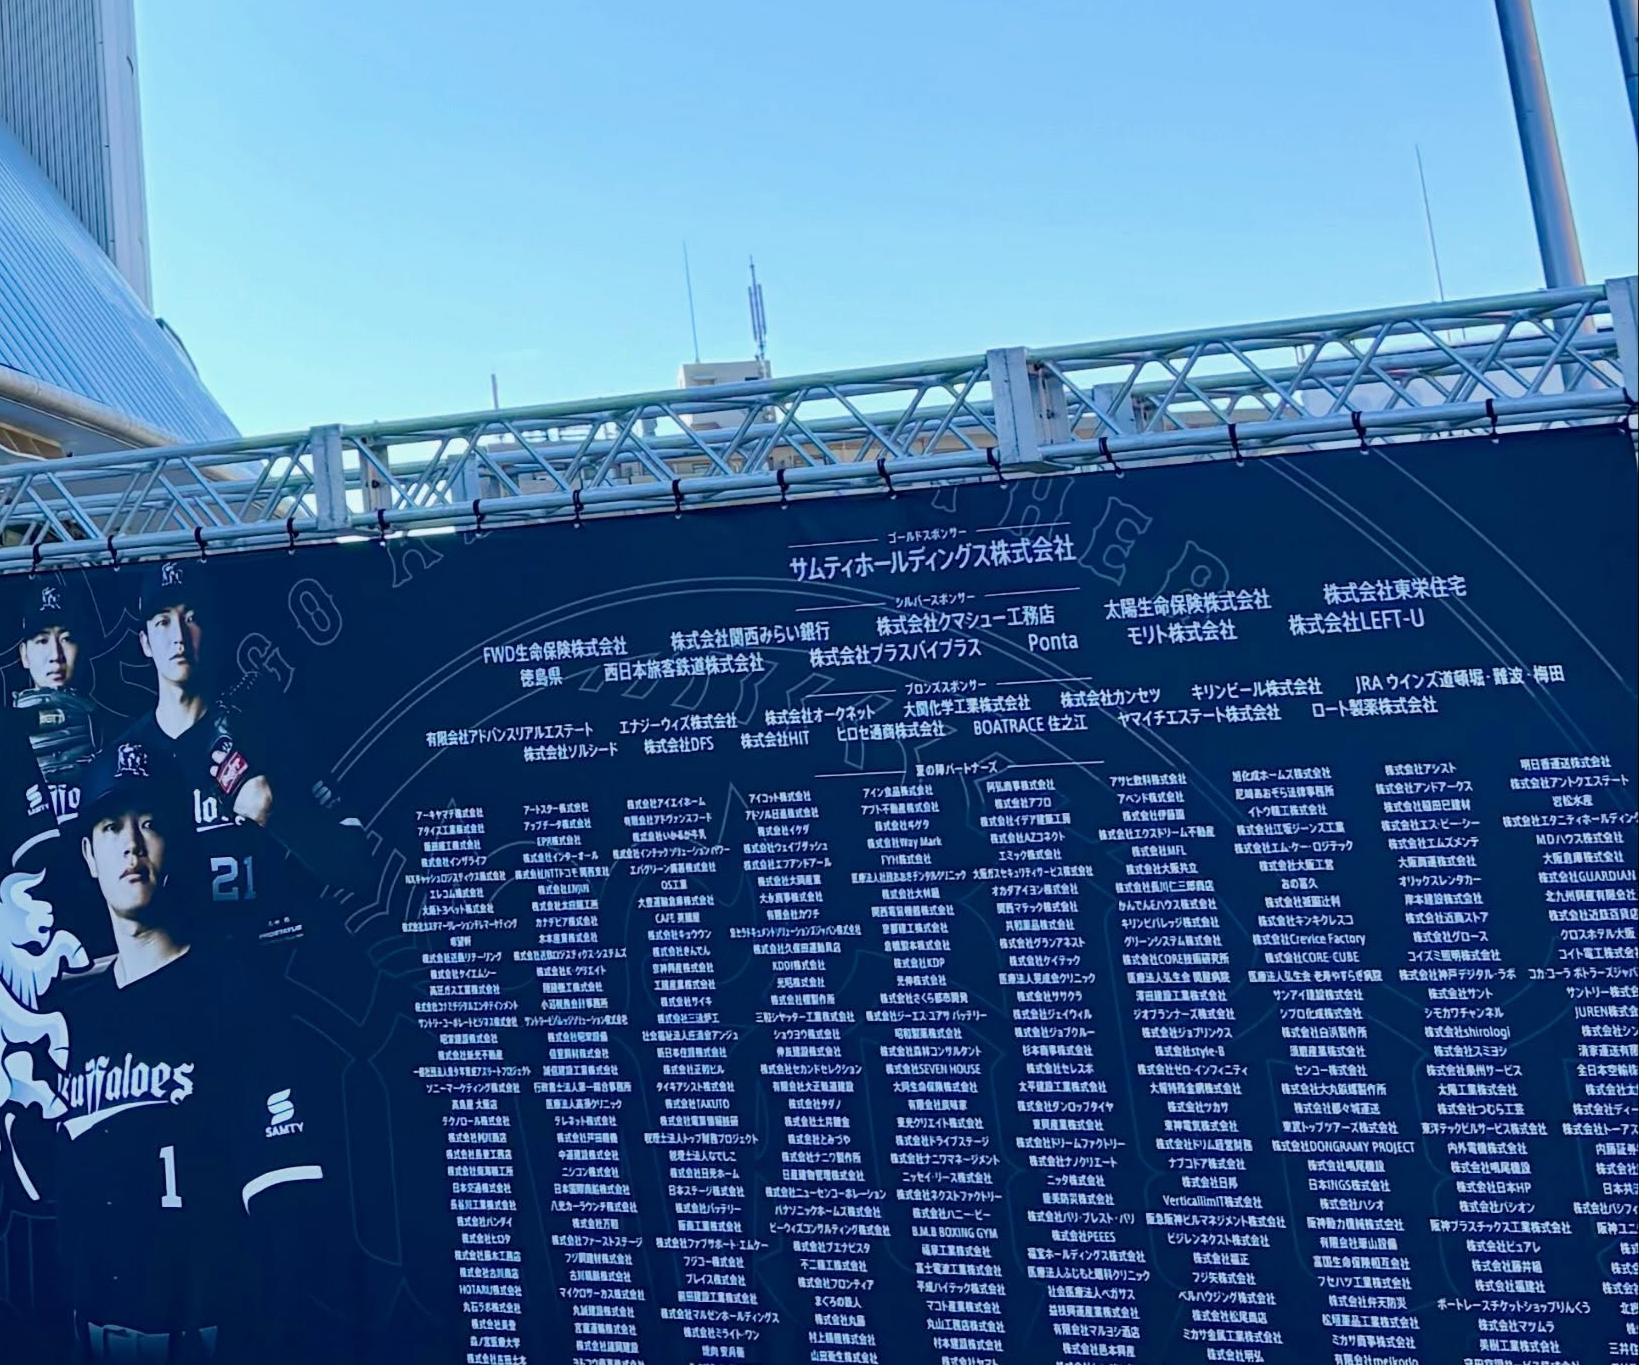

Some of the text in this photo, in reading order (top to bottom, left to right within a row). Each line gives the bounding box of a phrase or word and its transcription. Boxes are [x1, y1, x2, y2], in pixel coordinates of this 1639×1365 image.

[889, 528, 966, 543] ゴールドスポンサー
[790, 534, 1077, 582] サムティホールディングス株式会社
[896, 593, 974, 607] シルバースポンサー
[1323, 575, 1466, 604] 株式会社東栄住宅
[1104, 588, 1271, 619] 太陽生命保険株式会社
[877, 604, 1054, 636] 株式会社クマシュー工務店
[1128, 619, 1237, 644] モリト株式会社
[1288, 608, 1424, 635] 株式会社LEFT-U
[671, 622, 829, 651] 株式会社関西みらい銀行
[1029, 633, 1078, 651] Ponta
[484, 636, 627, 663] FWD生命保険株式会社
[521, 667, 562, 687] 徳島県
[604, 652, 764, 681] 西日本旅客鉄道株式会社
[905, 680, 987, 695] ブロンズスポンサー
[1192, 677, 1323, 700] キリンビール株式会社
[1355, 672, 1384, 696] JRA
[1061, 688, 1160, 708] 株式会社カンセツ
[1312, 696, 1438, 717] ロート製薬株式会社
[620, 712, 738, 733] エナジーウィズ株式会社
[765, 705, 875, 725] 株式会社オークネット
[973, 713, 1089, 736] BOATRACE 住之江
[1118, 703, 1281, 727] ヤマイチエステート株式会社
[426, 722, 592, 746] 有限会社アドバンスリアルエステート
[741, 731, 809, 749] 株式会社HIT
[837, 720, 946, 741] ヒロセ通商株式会社
[524, 742, 617, 761] 株式会社ソルシード
[644, 736, 713, 754] 株式会社DFS
[210, 855, 257, 902] 21
[57, 1052, 195, 1116] uffaloes
[265, 1122, 304, 1138] SAMTY
[159, 1145, 183, 1208] 1
